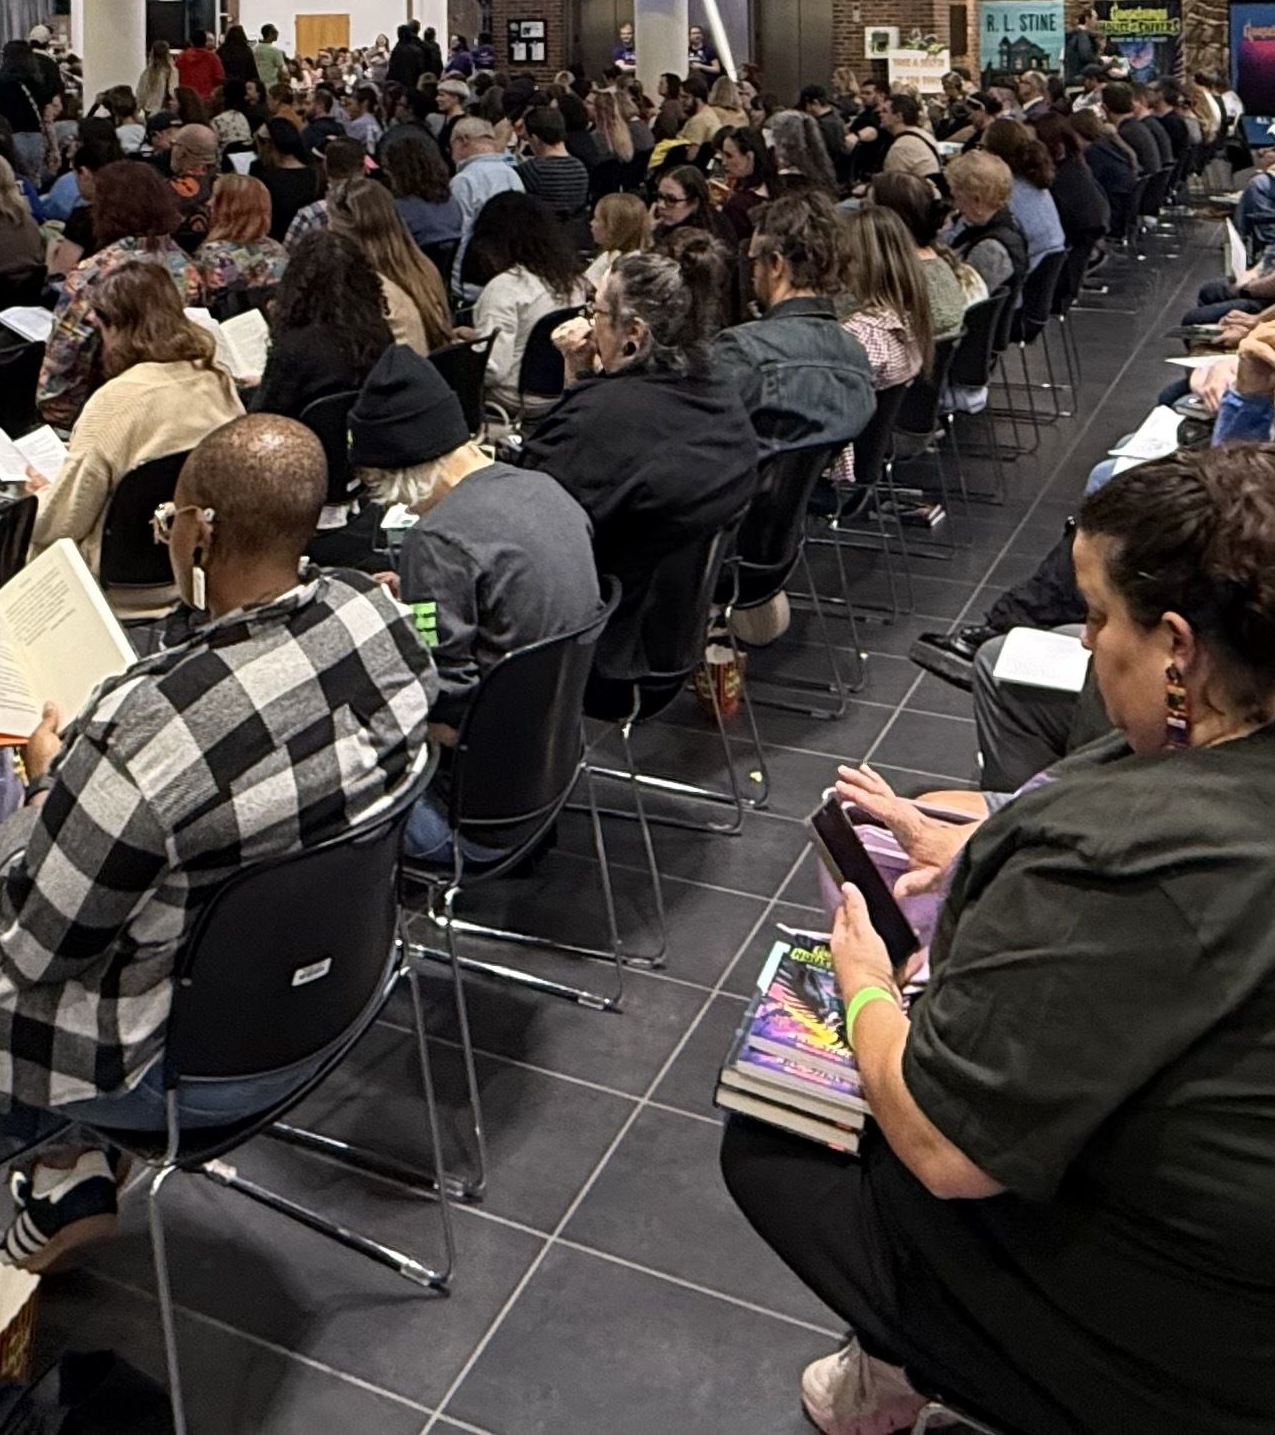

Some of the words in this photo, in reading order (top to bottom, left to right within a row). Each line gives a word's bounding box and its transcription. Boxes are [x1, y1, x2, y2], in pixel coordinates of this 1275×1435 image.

[987, 14, 998, 32] R.
[1004, 14, 1015, 32] L.
[1019, 13, 1056, 32] STINE
